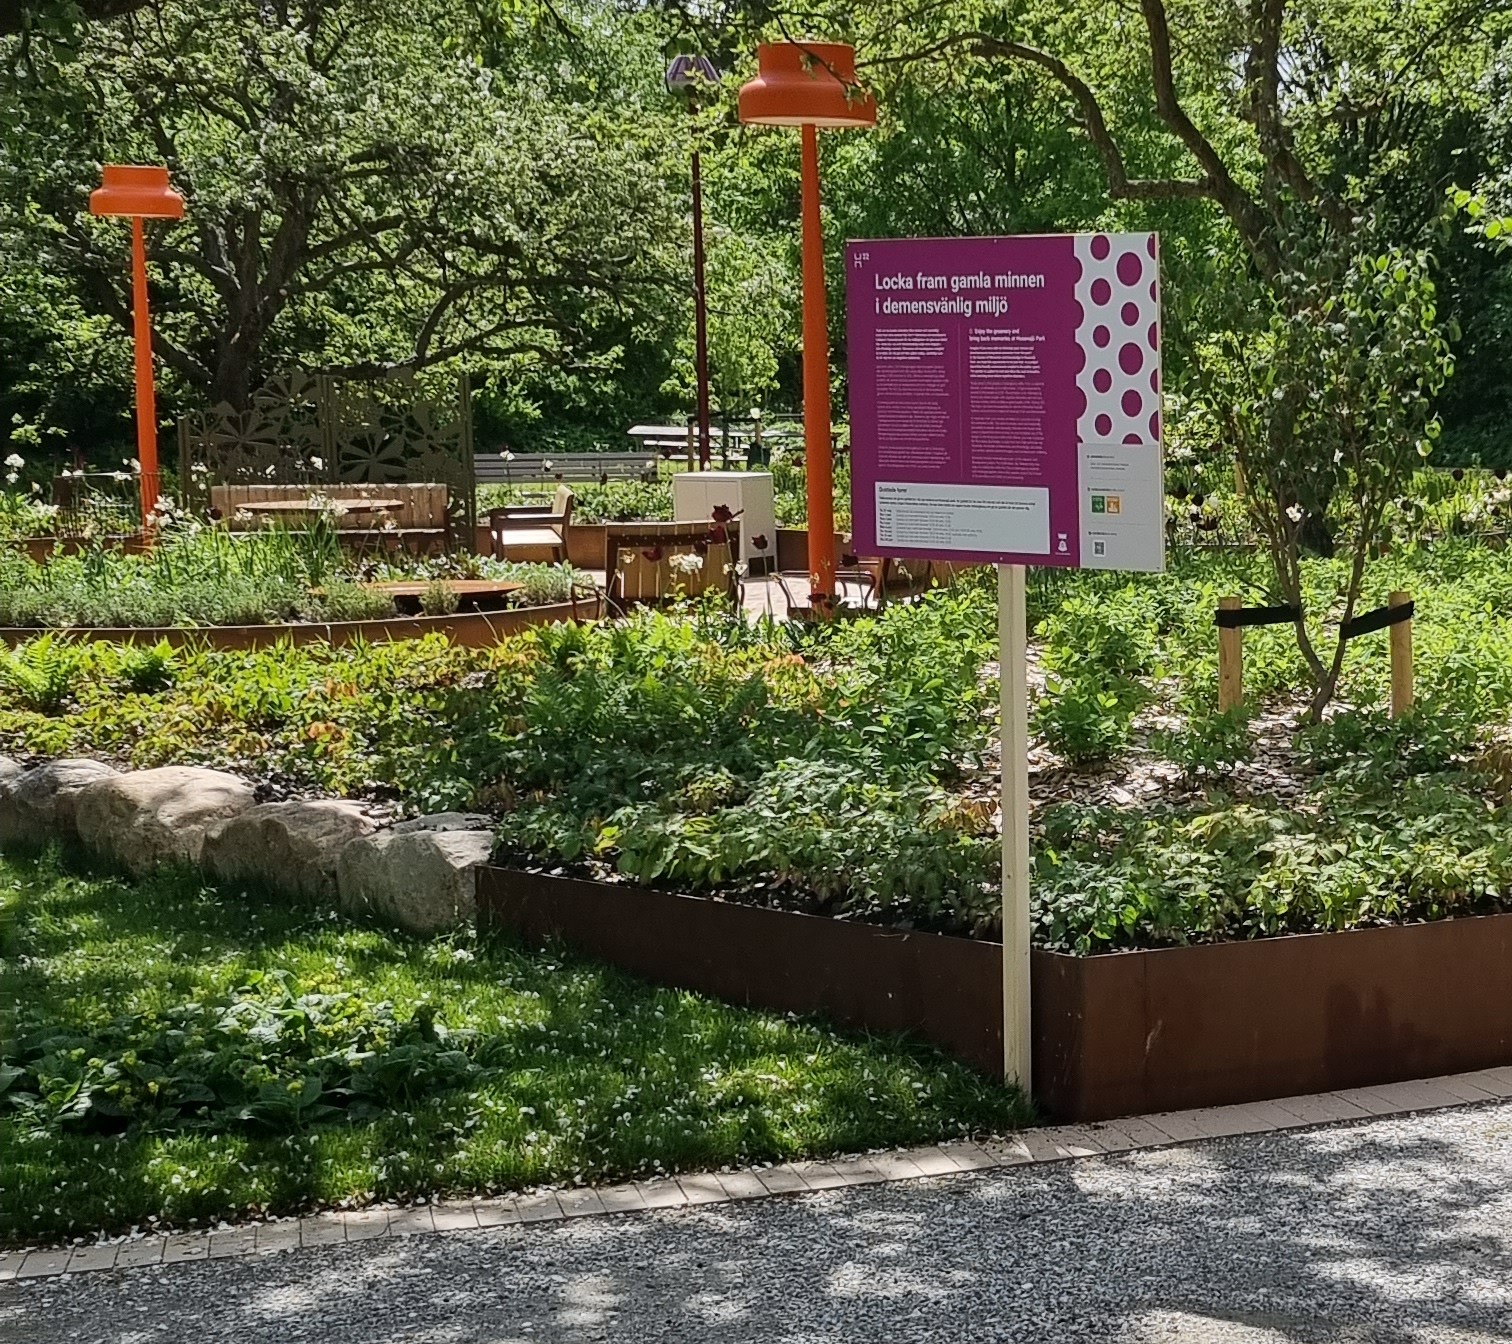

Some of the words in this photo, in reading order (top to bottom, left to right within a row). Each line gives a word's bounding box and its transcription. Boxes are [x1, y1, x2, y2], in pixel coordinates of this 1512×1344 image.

[875, 273, 913, 289] Locka
[916, 272, 947, 289] fram
[950, 271, 991, 292] gamla
[994, 271, 1045, 288] minnen
[875, 298, 880, 314] i
[883, 296, 972, 317] demensvänlig
[976, 296, 1008, 317] miljö
